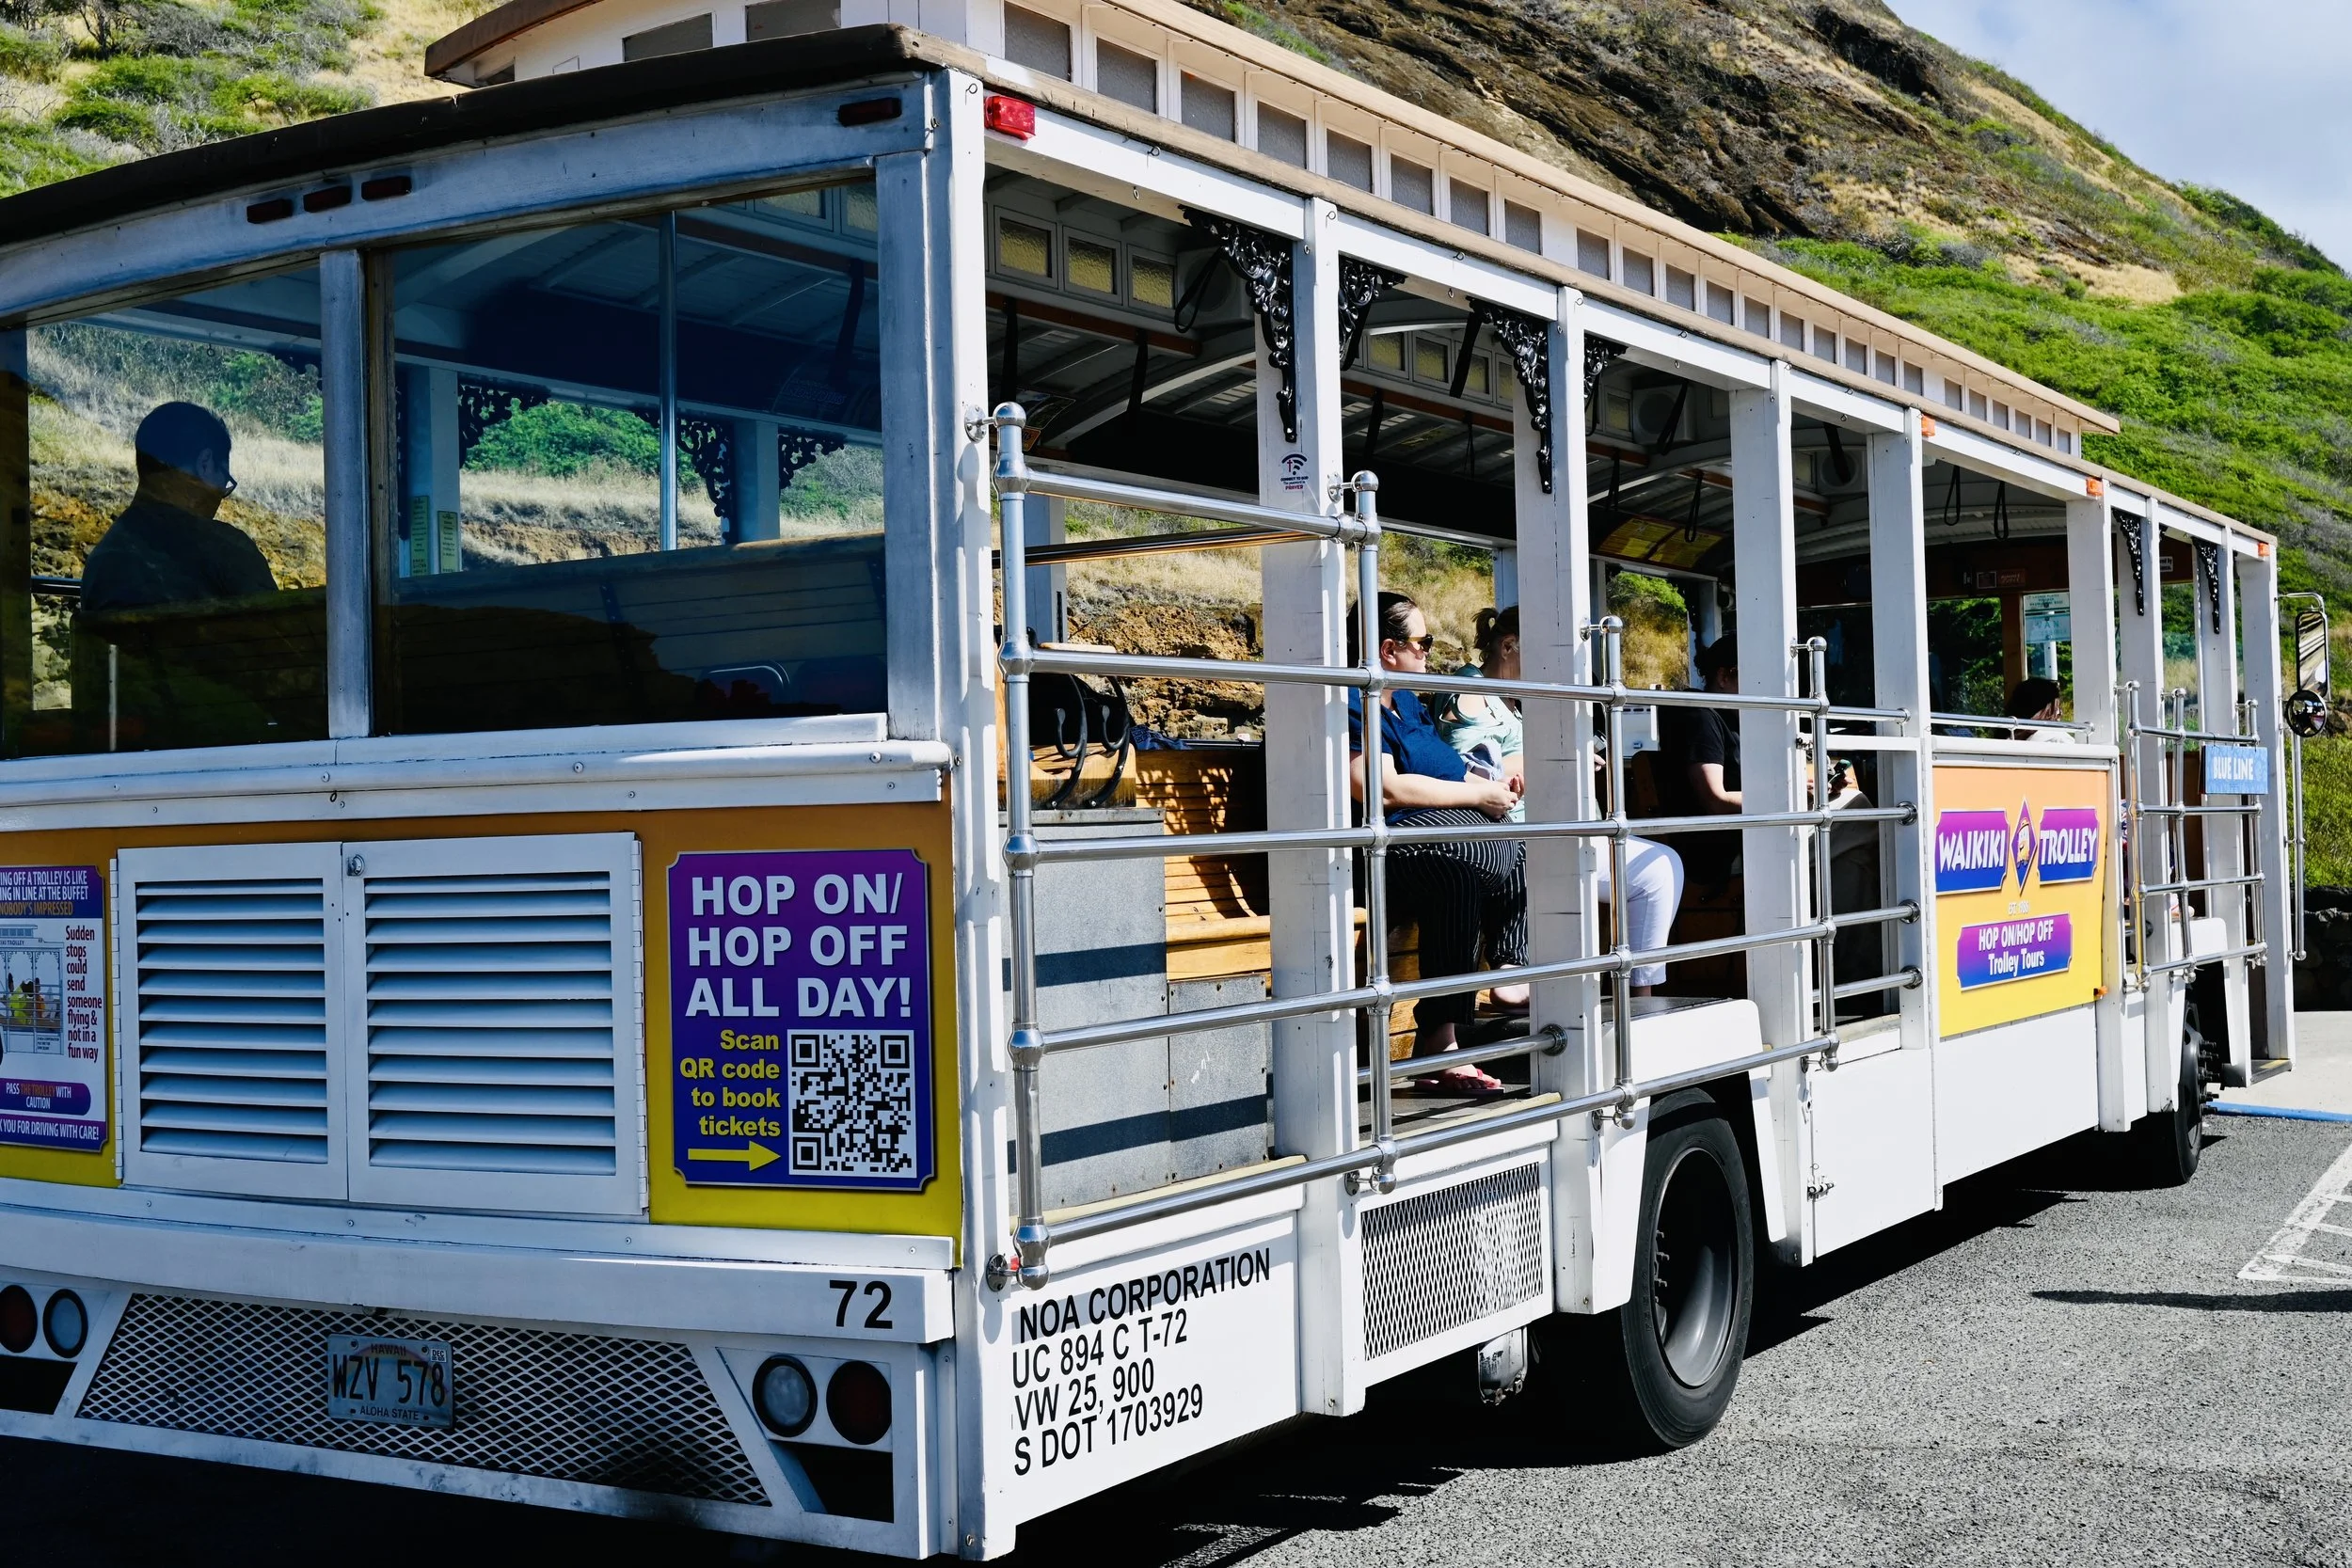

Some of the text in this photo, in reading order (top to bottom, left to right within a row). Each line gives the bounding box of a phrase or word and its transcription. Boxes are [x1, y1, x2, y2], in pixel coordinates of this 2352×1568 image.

[2213, 756, 2254, 780] BLUE LINE
[1939, 828, 2097, 873] WAIKIKI TROLLEY
[13, 871, 26, 886] OFF
[27, 871, 32, 886] A
[33, 871, 63, 885] TROLLEY
[64, 871, 72, 885] IS
[72, 870, 87, 885] LIKE
[13, 886, 21, 900] IN
[22, 886, 38, 900] LINE
[39, 886, 47, 900] AT
[47, 886, 61, 900] THE
[62, 886, 88, 900] BUFFET
[692, 873, 902, 915] HOP ON/
[34, 902, 73, 915] IMPRESSED
[66, 926, 95, 941] Sudden
[1979, 927, 1999, 951] HOP
[2037, 919, 2054, 942] OFF
[66, 943, 87, 959] stops
[689, 926, 908, 966] HOP OFF
[67, 959, 87, 974] could
[1988, 948, 2044, 977] Trolley Tours
[67, 975, 86, 990] send
[68, 996, 103, 1008] someone
[685, 978, 911, 1018] ALL DAY!
[68, 1009, 98, 1028] flying &
[68, 1027, 96, 1042] not in a
[721, 1030, 779, 1051] Scan
[68, 1042, 82, 1058] fun
[83, 1048, 99, 1063] way
[680, 1058, 780, 1079] QR code
[6, 1083, 72, 1099] PASS THE TROLLEY WITH
[691, 1088, 781, 1108] to book
[26, 1096, 51, 1109] CAUTION
[3, 1119, 16, 1133] YOU
[17, 1120, 30, 1134] FOR
[31, 1121, 58, 1136] DRIVING
[59, 1124, 77, 1138] WITH
[79, 1126, 99, 1140] CARE!
[699, 1117, 781, 1137] tickets
[829, 1280, 893, 1329] 72
[1020, 1247, 1270, 1343] NOA CORPORATION
[371, 1343, 406, 1356] HAWAII
[432, 1349, 444, 1357] DEC
[1012, 1308, 1187, 1388] UC 894 C T-72
[333, 1354, 445, 1407] WZV 578
[1015, 1357, 1154, 1431] VW 25, 900
[360, 1405, 419, 1420] ALOHA STATE
[1014, 1384, 1203, 1476] S DOT 1703929
